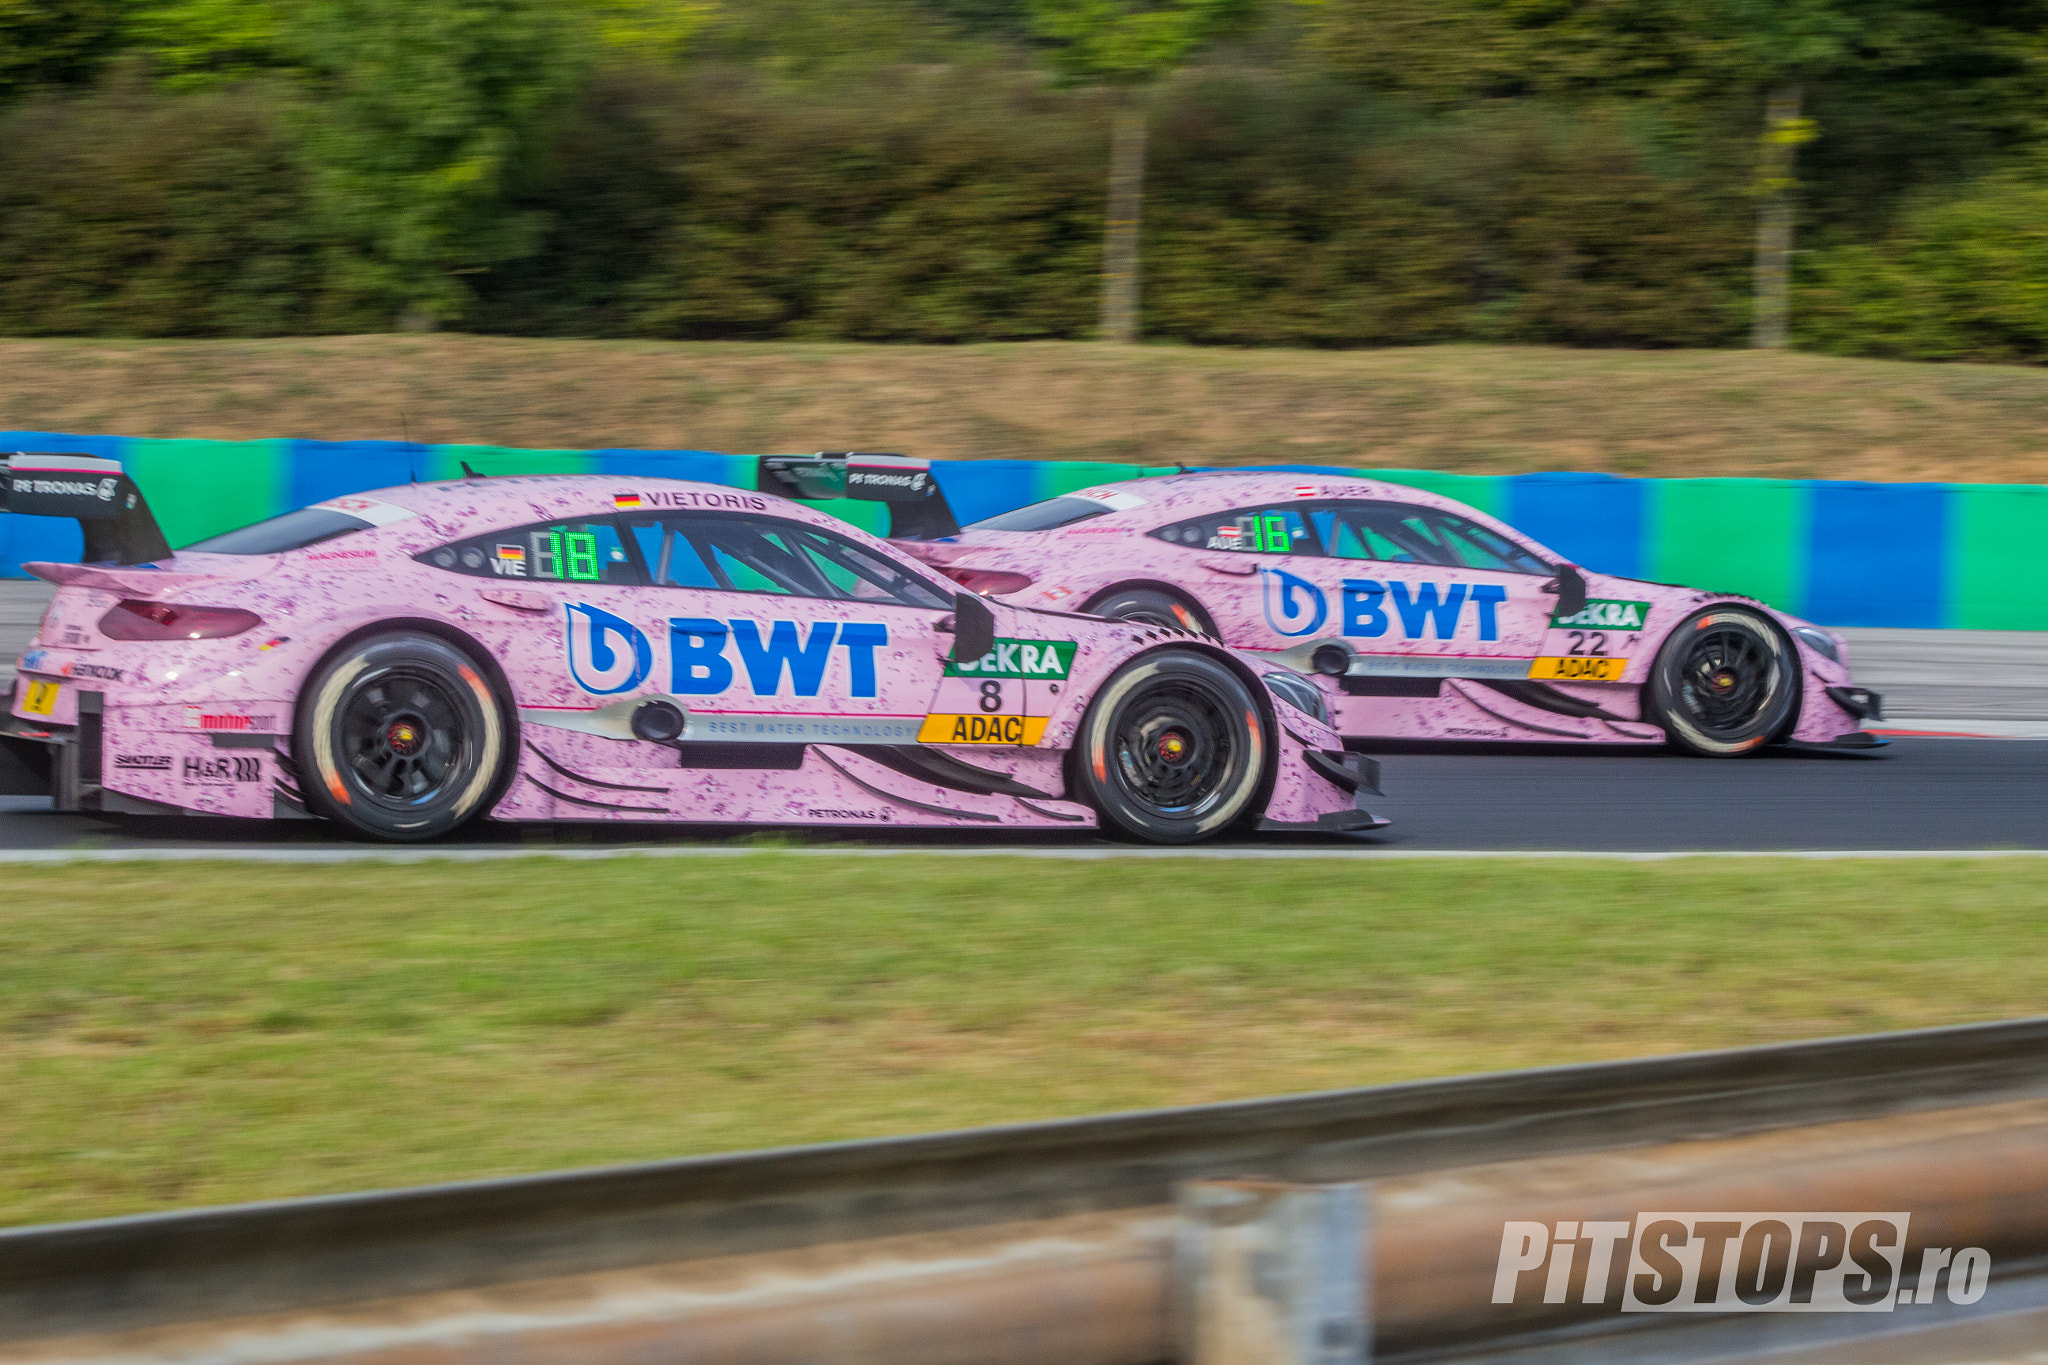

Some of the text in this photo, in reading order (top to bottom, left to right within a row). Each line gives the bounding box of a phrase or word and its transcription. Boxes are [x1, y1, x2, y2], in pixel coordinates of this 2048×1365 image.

[13, 479, 98, 497] PETRONAS
[849, 473, 913, 488] PETRONAS
[1320, 485, 1372, 497] AUER
[645, 491, 767, 512] VIETORIS
[1252, 515, 1291, 552] 16
[549, 531, 600, 580] 18
[489, 557, 527, 577] VIE
[1340, 577, 1508, 642] BWT
[1567, 631, 1609, 656] 22
[668, 616, 889, 699] BWT
[1556, 658, 1609, 679] ADAC
[980, 680, 1002, 713] 8
[708, 721, 913, 738] BEST WATER TECHNOLOGY
[952, 716, 1022, 742] ADAC
[808, 808, 877, 821] PETRONAS
